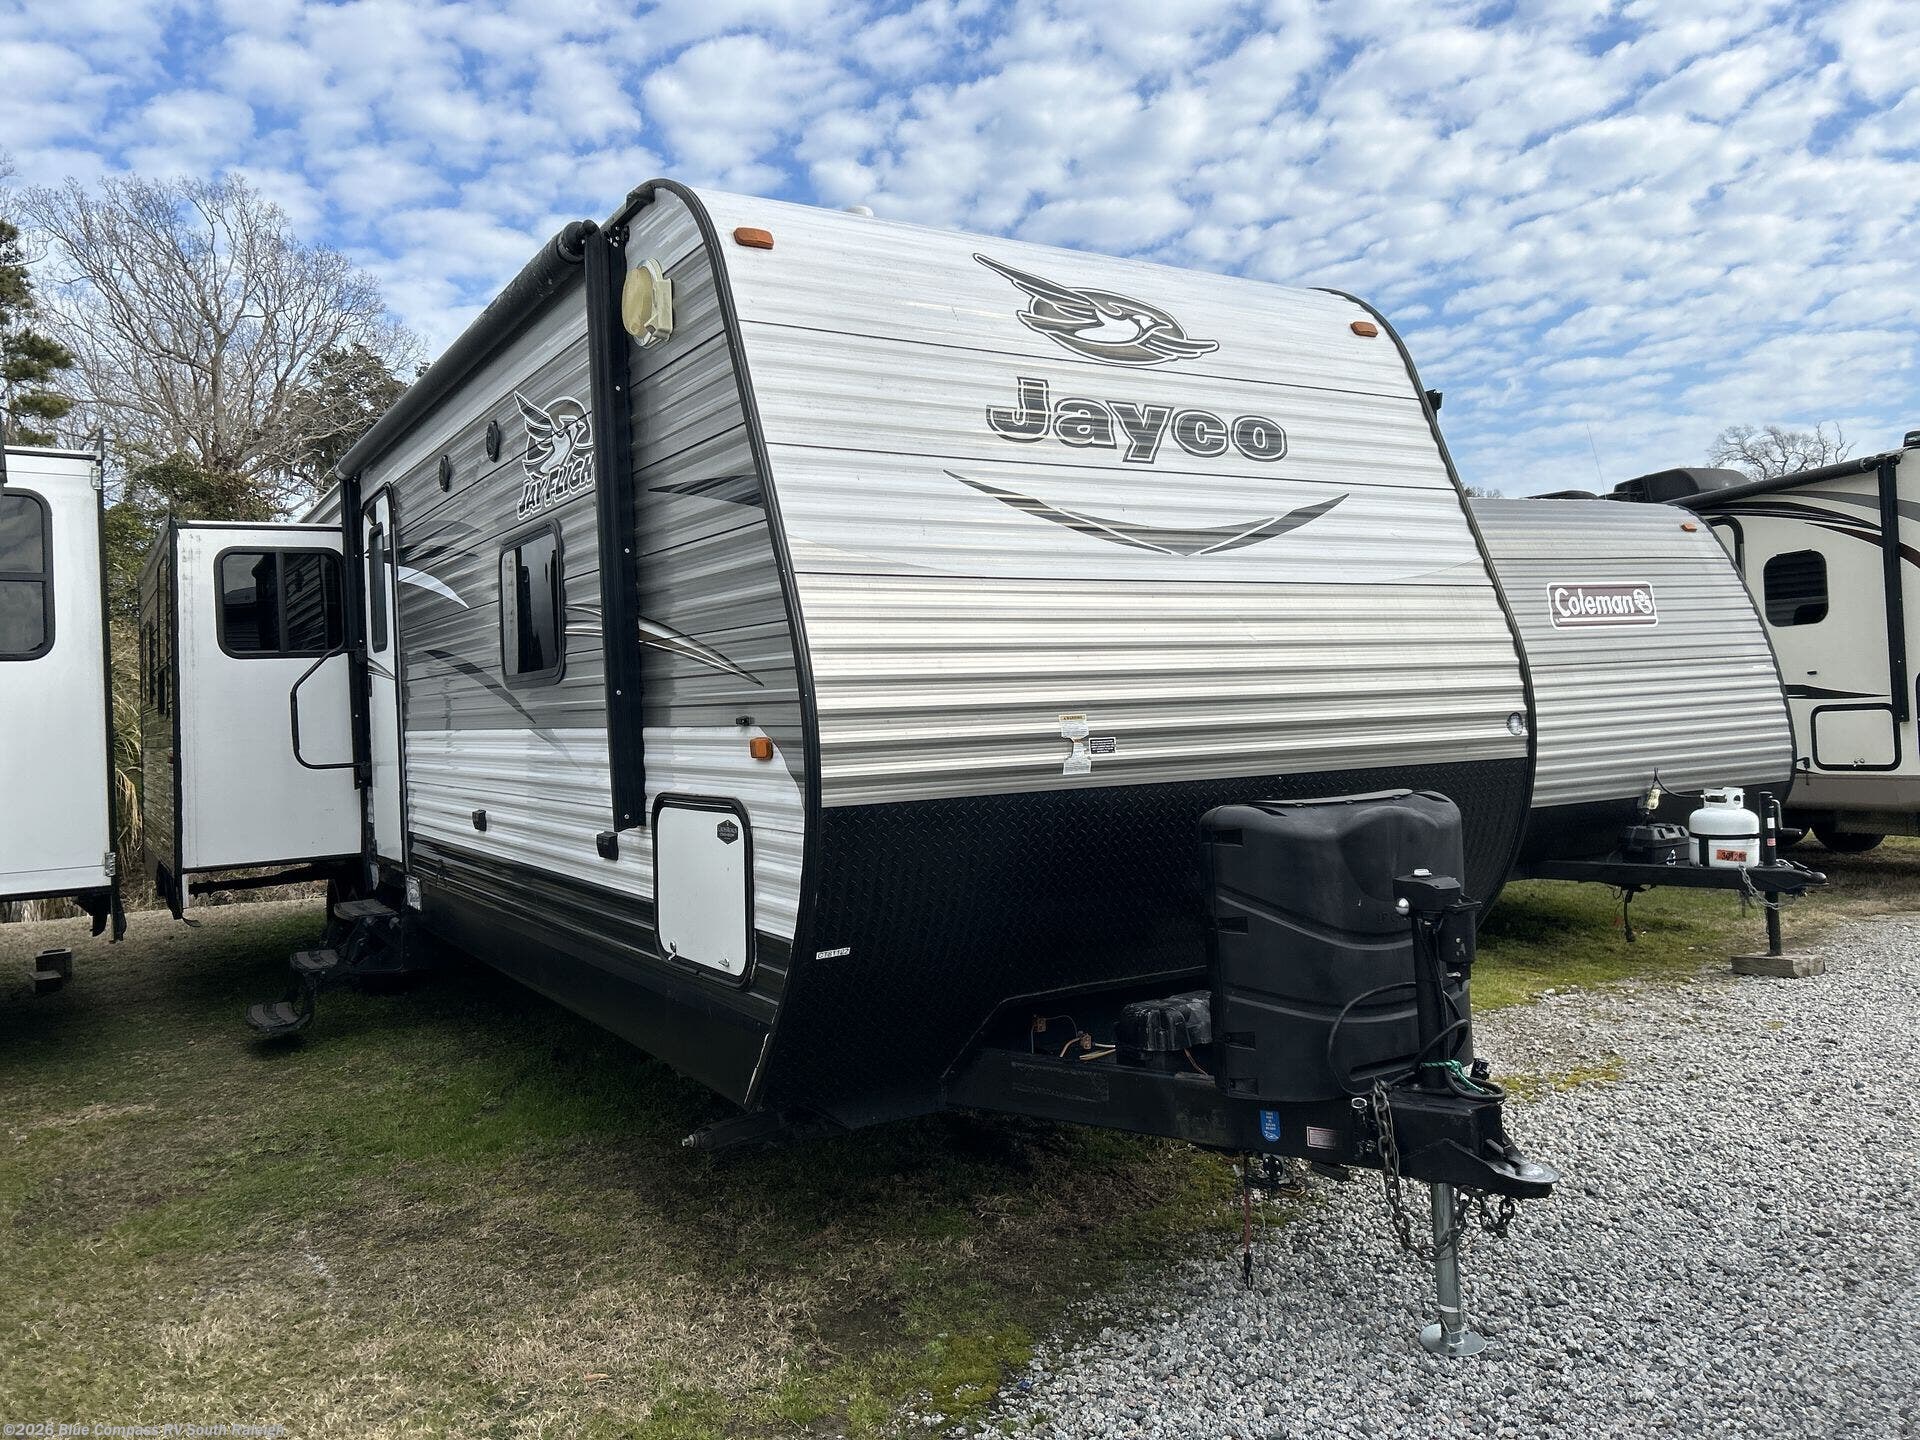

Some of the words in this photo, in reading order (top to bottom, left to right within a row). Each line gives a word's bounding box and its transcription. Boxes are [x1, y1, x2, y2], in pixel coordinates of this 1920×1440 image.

[986, 376, 1288, 464] Jayco
[517, 476, 550, 520] JAY
[544, 451, 595, 508] FLIGH
[1554, 587, 1635, 617] Coleman
